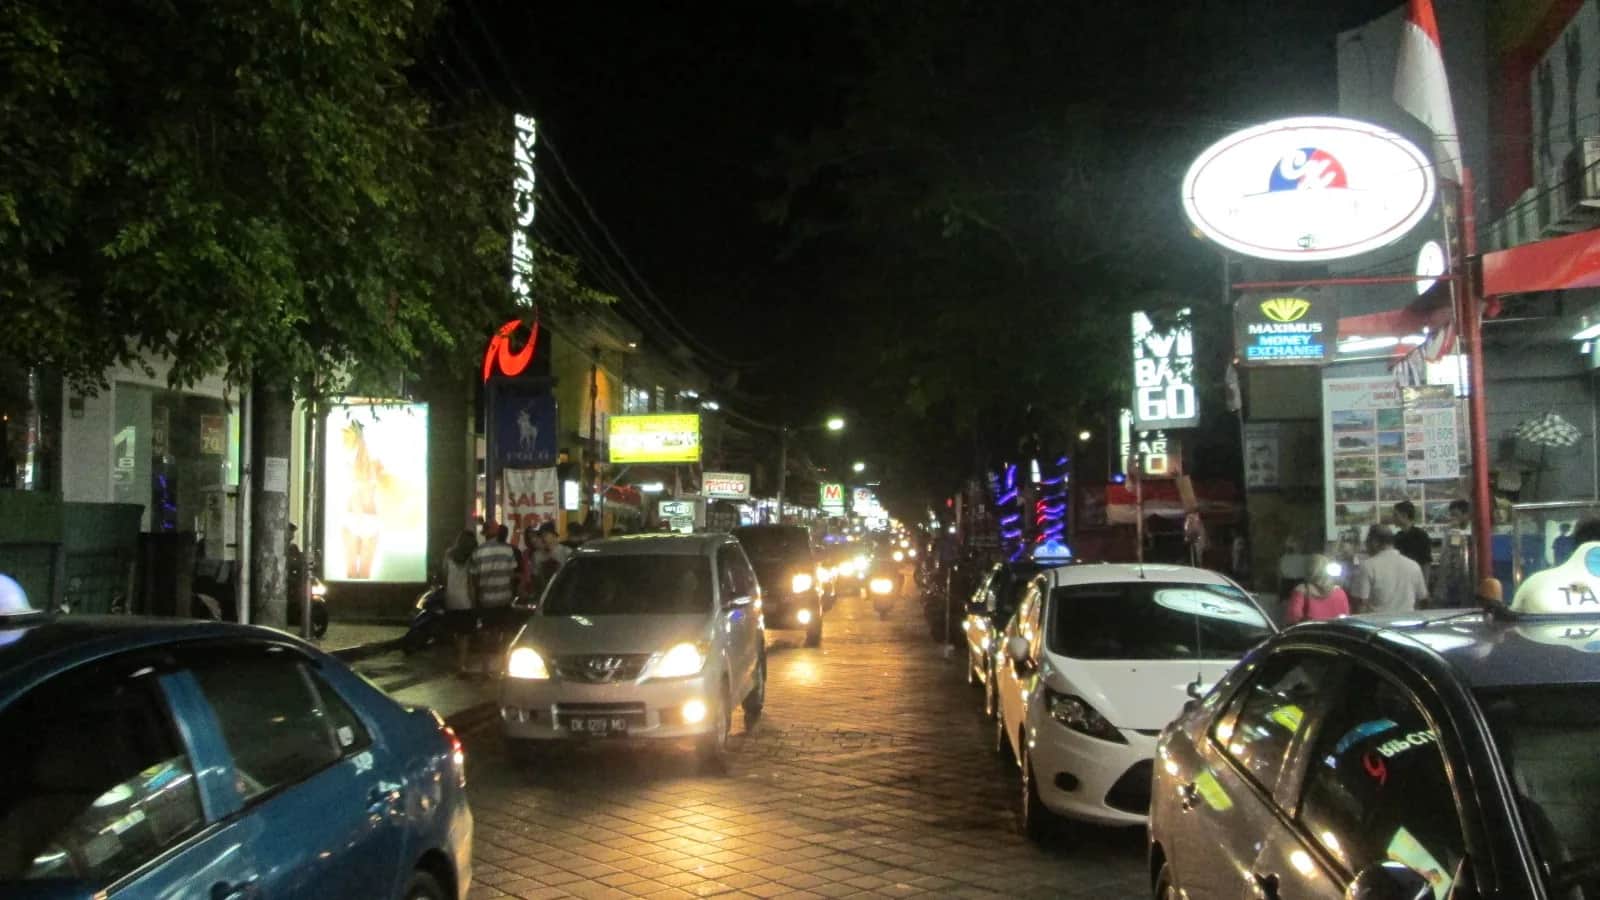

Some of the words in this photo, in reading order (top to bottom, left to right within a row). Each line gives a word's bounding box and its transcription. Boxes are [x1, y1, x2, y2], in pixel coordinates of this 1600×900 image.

[1248, 322, 1322, 334] MAXIMUS
[1259, 334, 1311, 345] MONEY
[1248, 345, 1323, 357] EXCHANGE
[508, 491, 555, 508] SALE
[1558, 584, 1600, 606] TA
